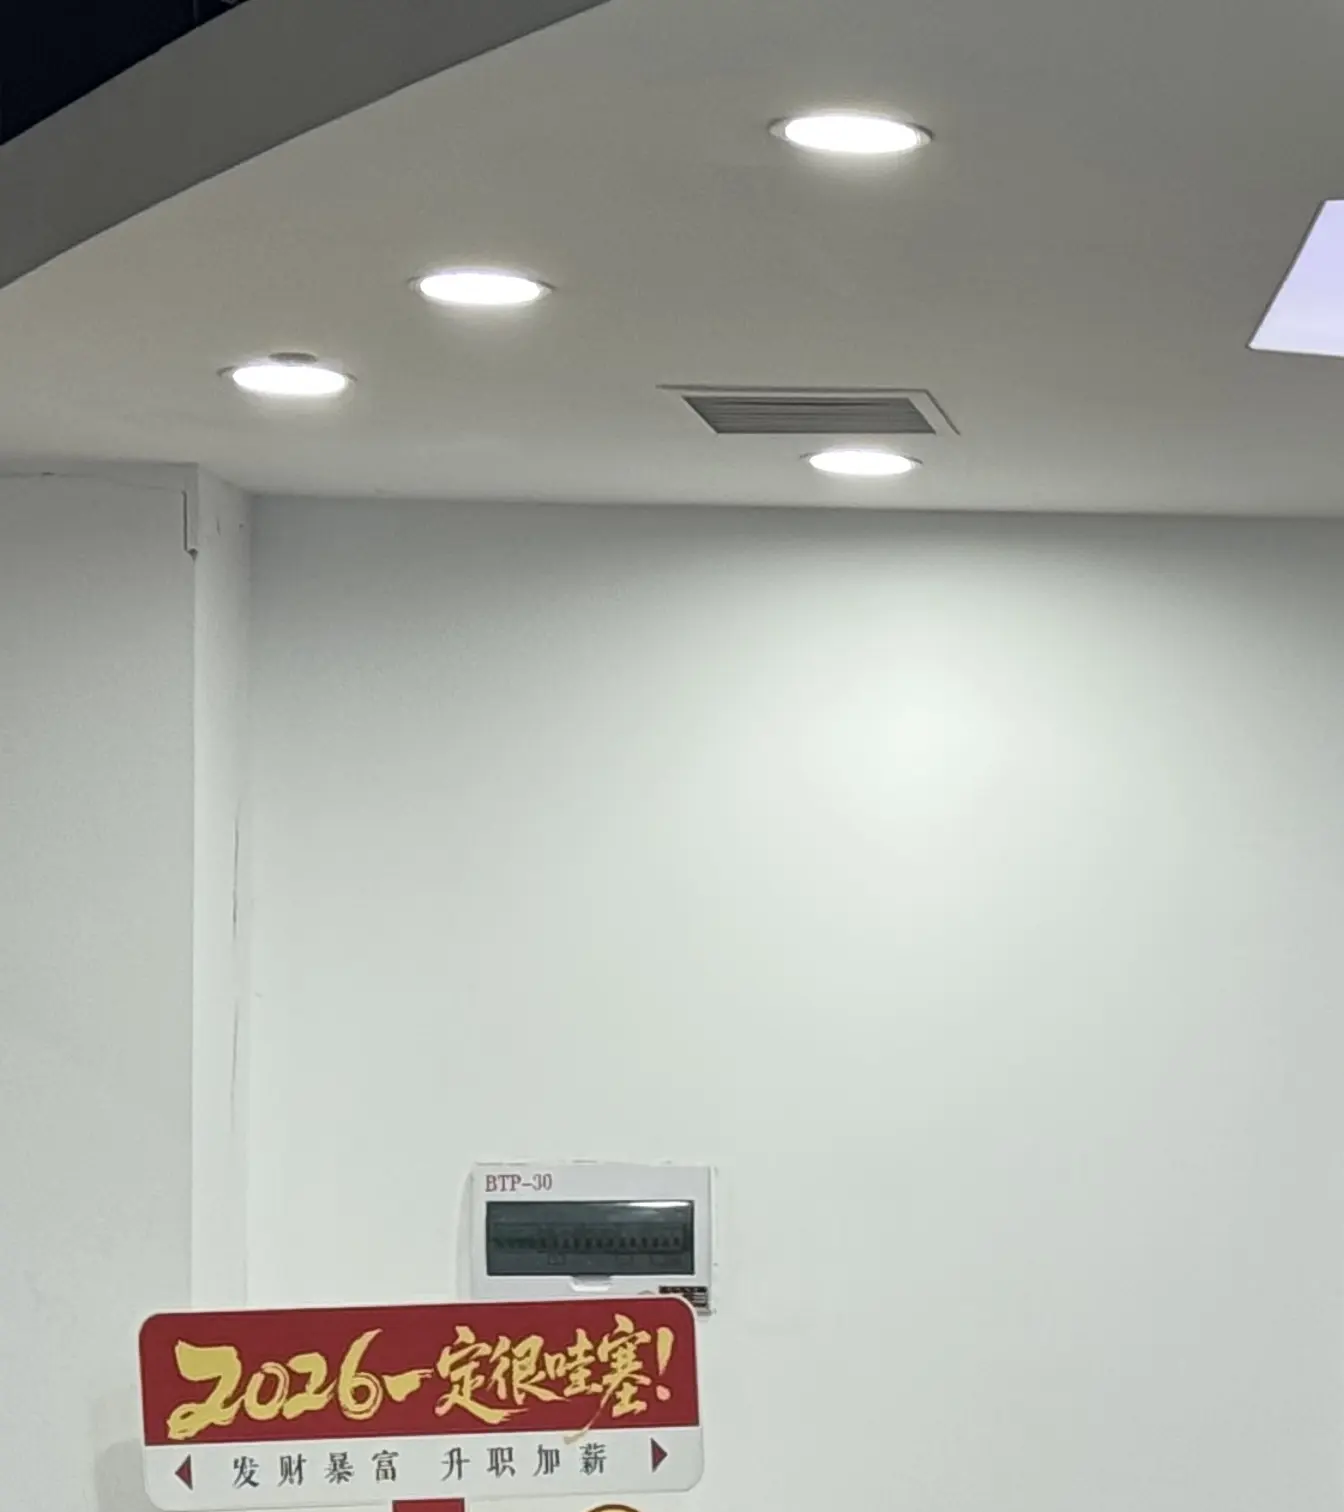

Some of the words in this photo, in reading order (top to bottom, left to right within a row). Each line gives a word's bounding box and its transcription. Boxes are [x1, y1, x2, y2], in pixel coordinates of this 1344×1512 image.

[166, 1314, 675, 1443] 2026一定很哇塞!
[232, 1447, 400, 1489] 发财暴富
[440, 1443, 608, 1481] 升职加薪
